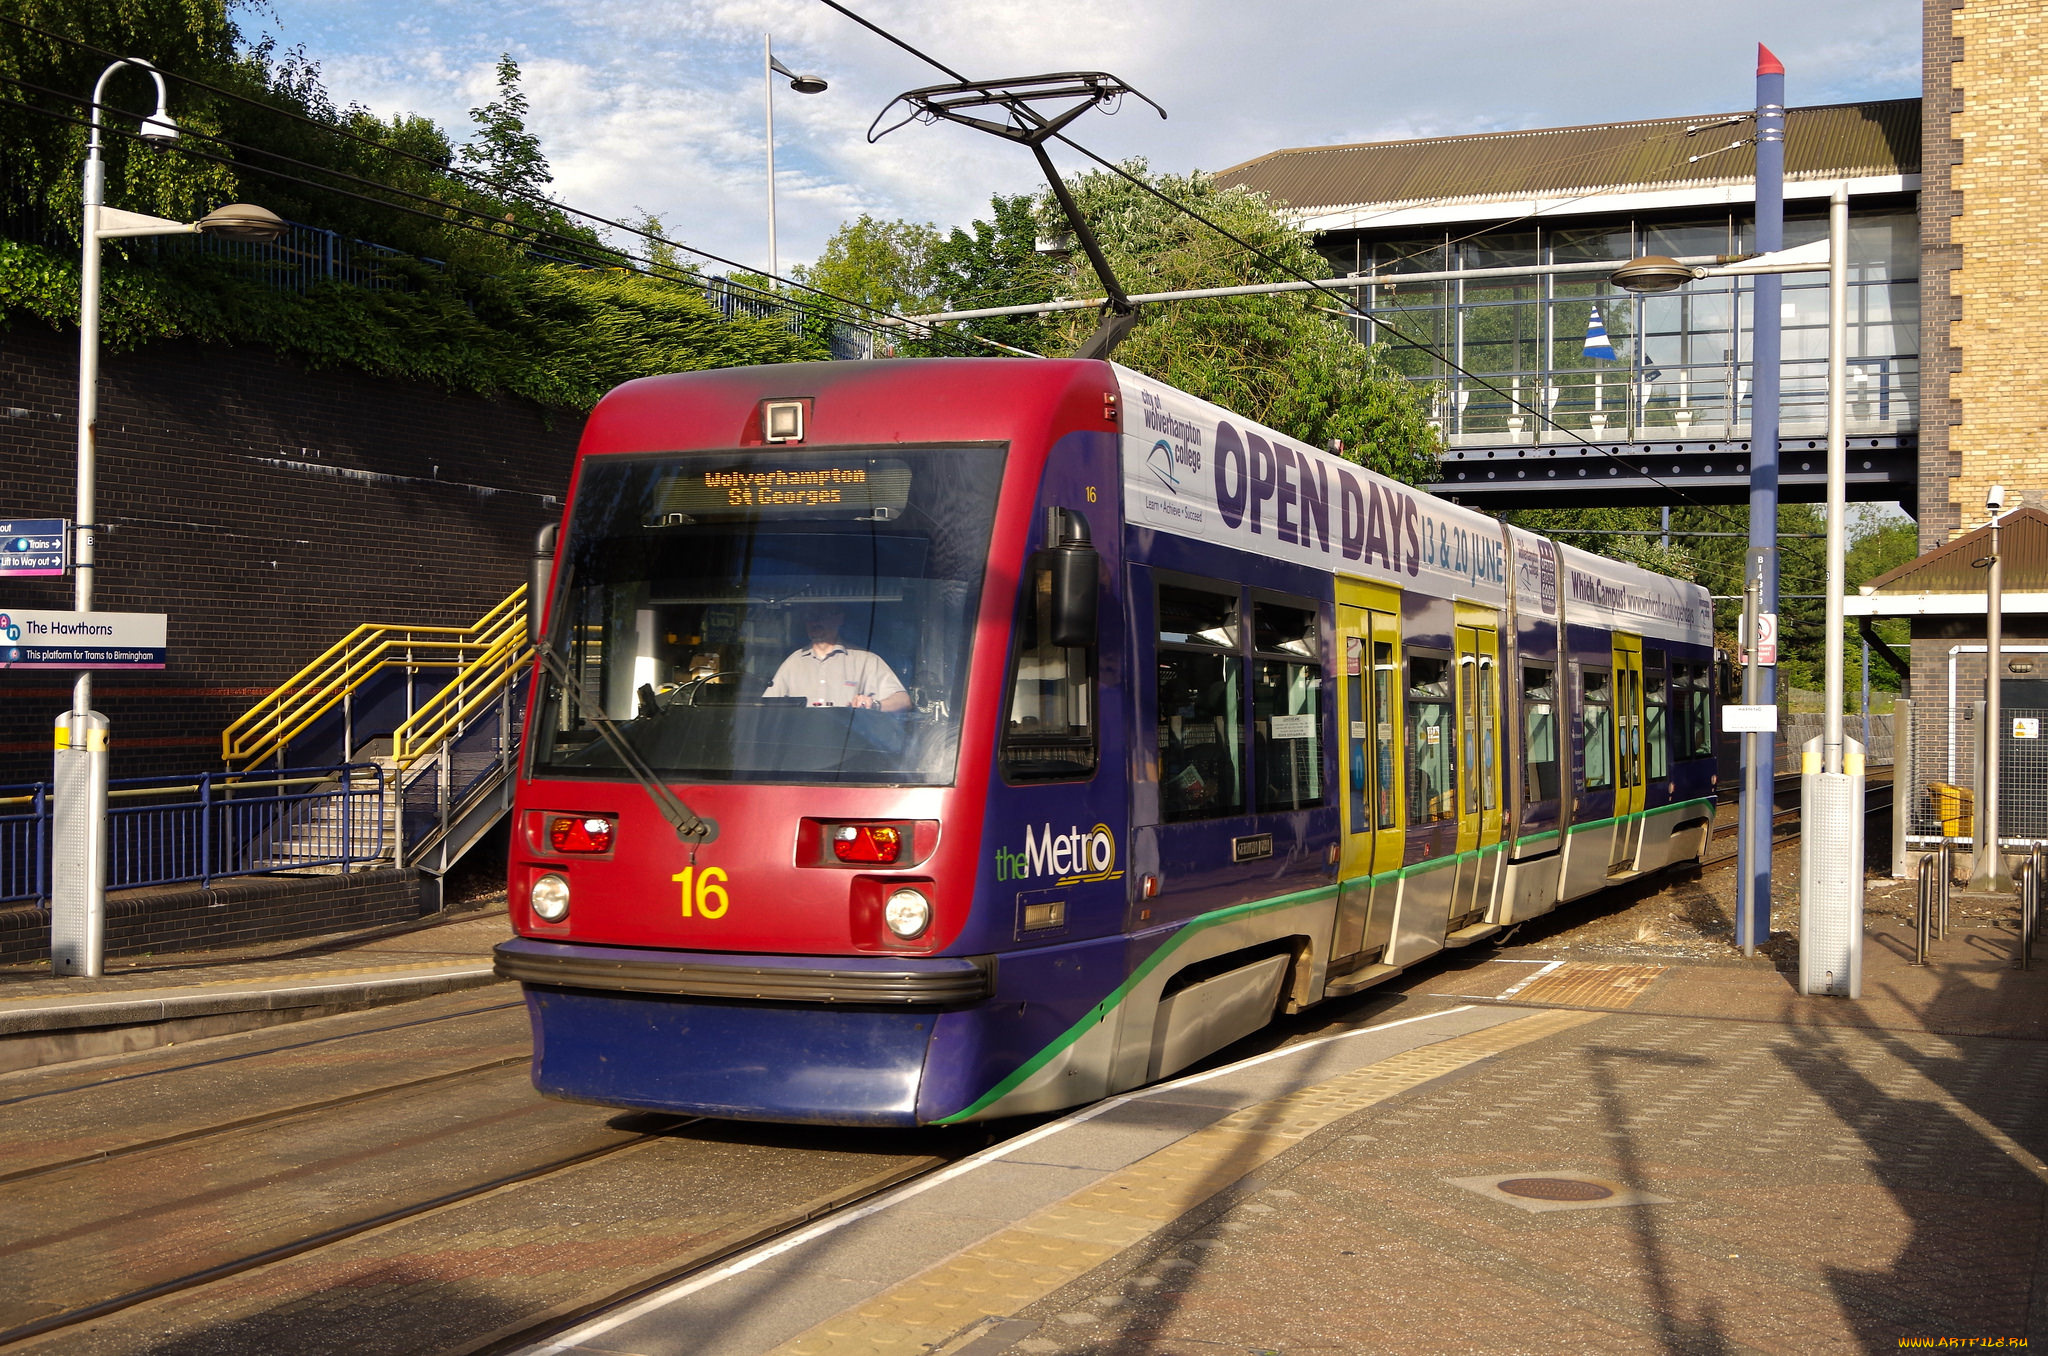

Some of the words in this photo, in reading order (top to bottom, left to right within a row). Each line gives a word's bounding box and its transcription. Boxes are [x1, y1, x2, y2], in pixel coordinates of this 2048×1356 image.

[1141, 389, 1154, 410] city
[1144, 408, 1201, 447] wolverhampton
[1175, 443, 1201, 474] college
[705, 468, 866, 487] Wolverhampton
[728, 488, 752, 505] St
[758, 488, 841, 505] Georges
[1085, 486, 1097, 503] 16
[1214, 420, 1330, 553] OPEN
[1338, 467, 1419, 578] DAYS
[1422, 515, 1434, 564] 13
[1440, 522, 1450, 569] &
[1454, 526, 1467, 573] 20
[1471, 532, 1503, 588] JUNE
[1146, 496, 1160, 511] Learn
[1163, 500, 1181, 517] Achieve
[1185, 506, 1203, 523] Succeed
[29, 540, 50, 549] Trains
[1, 556, 11, 566] Lift
[12, 557, 20, 566] to
[21, 556, 37, 568] Way
[37, 556, 50, 566] out
[1572, 570, 1595, 603] Which
[26, 620, 48, 635] The
[51, 621, 113, 636] Hawthorns
[26, 650, 41, 660] This
[42, 650, 73, 662] platform
[73, 650, 84, 660] for
[84, 651, 105, 661] Trams
[105, 651, 113, 661] to
[114, 651, 154, 663] Birmingham
[995, 846, 1028, 882] the
[1024, 822, 1111, 879] Metro
[671, 866, 729, 919] 16
